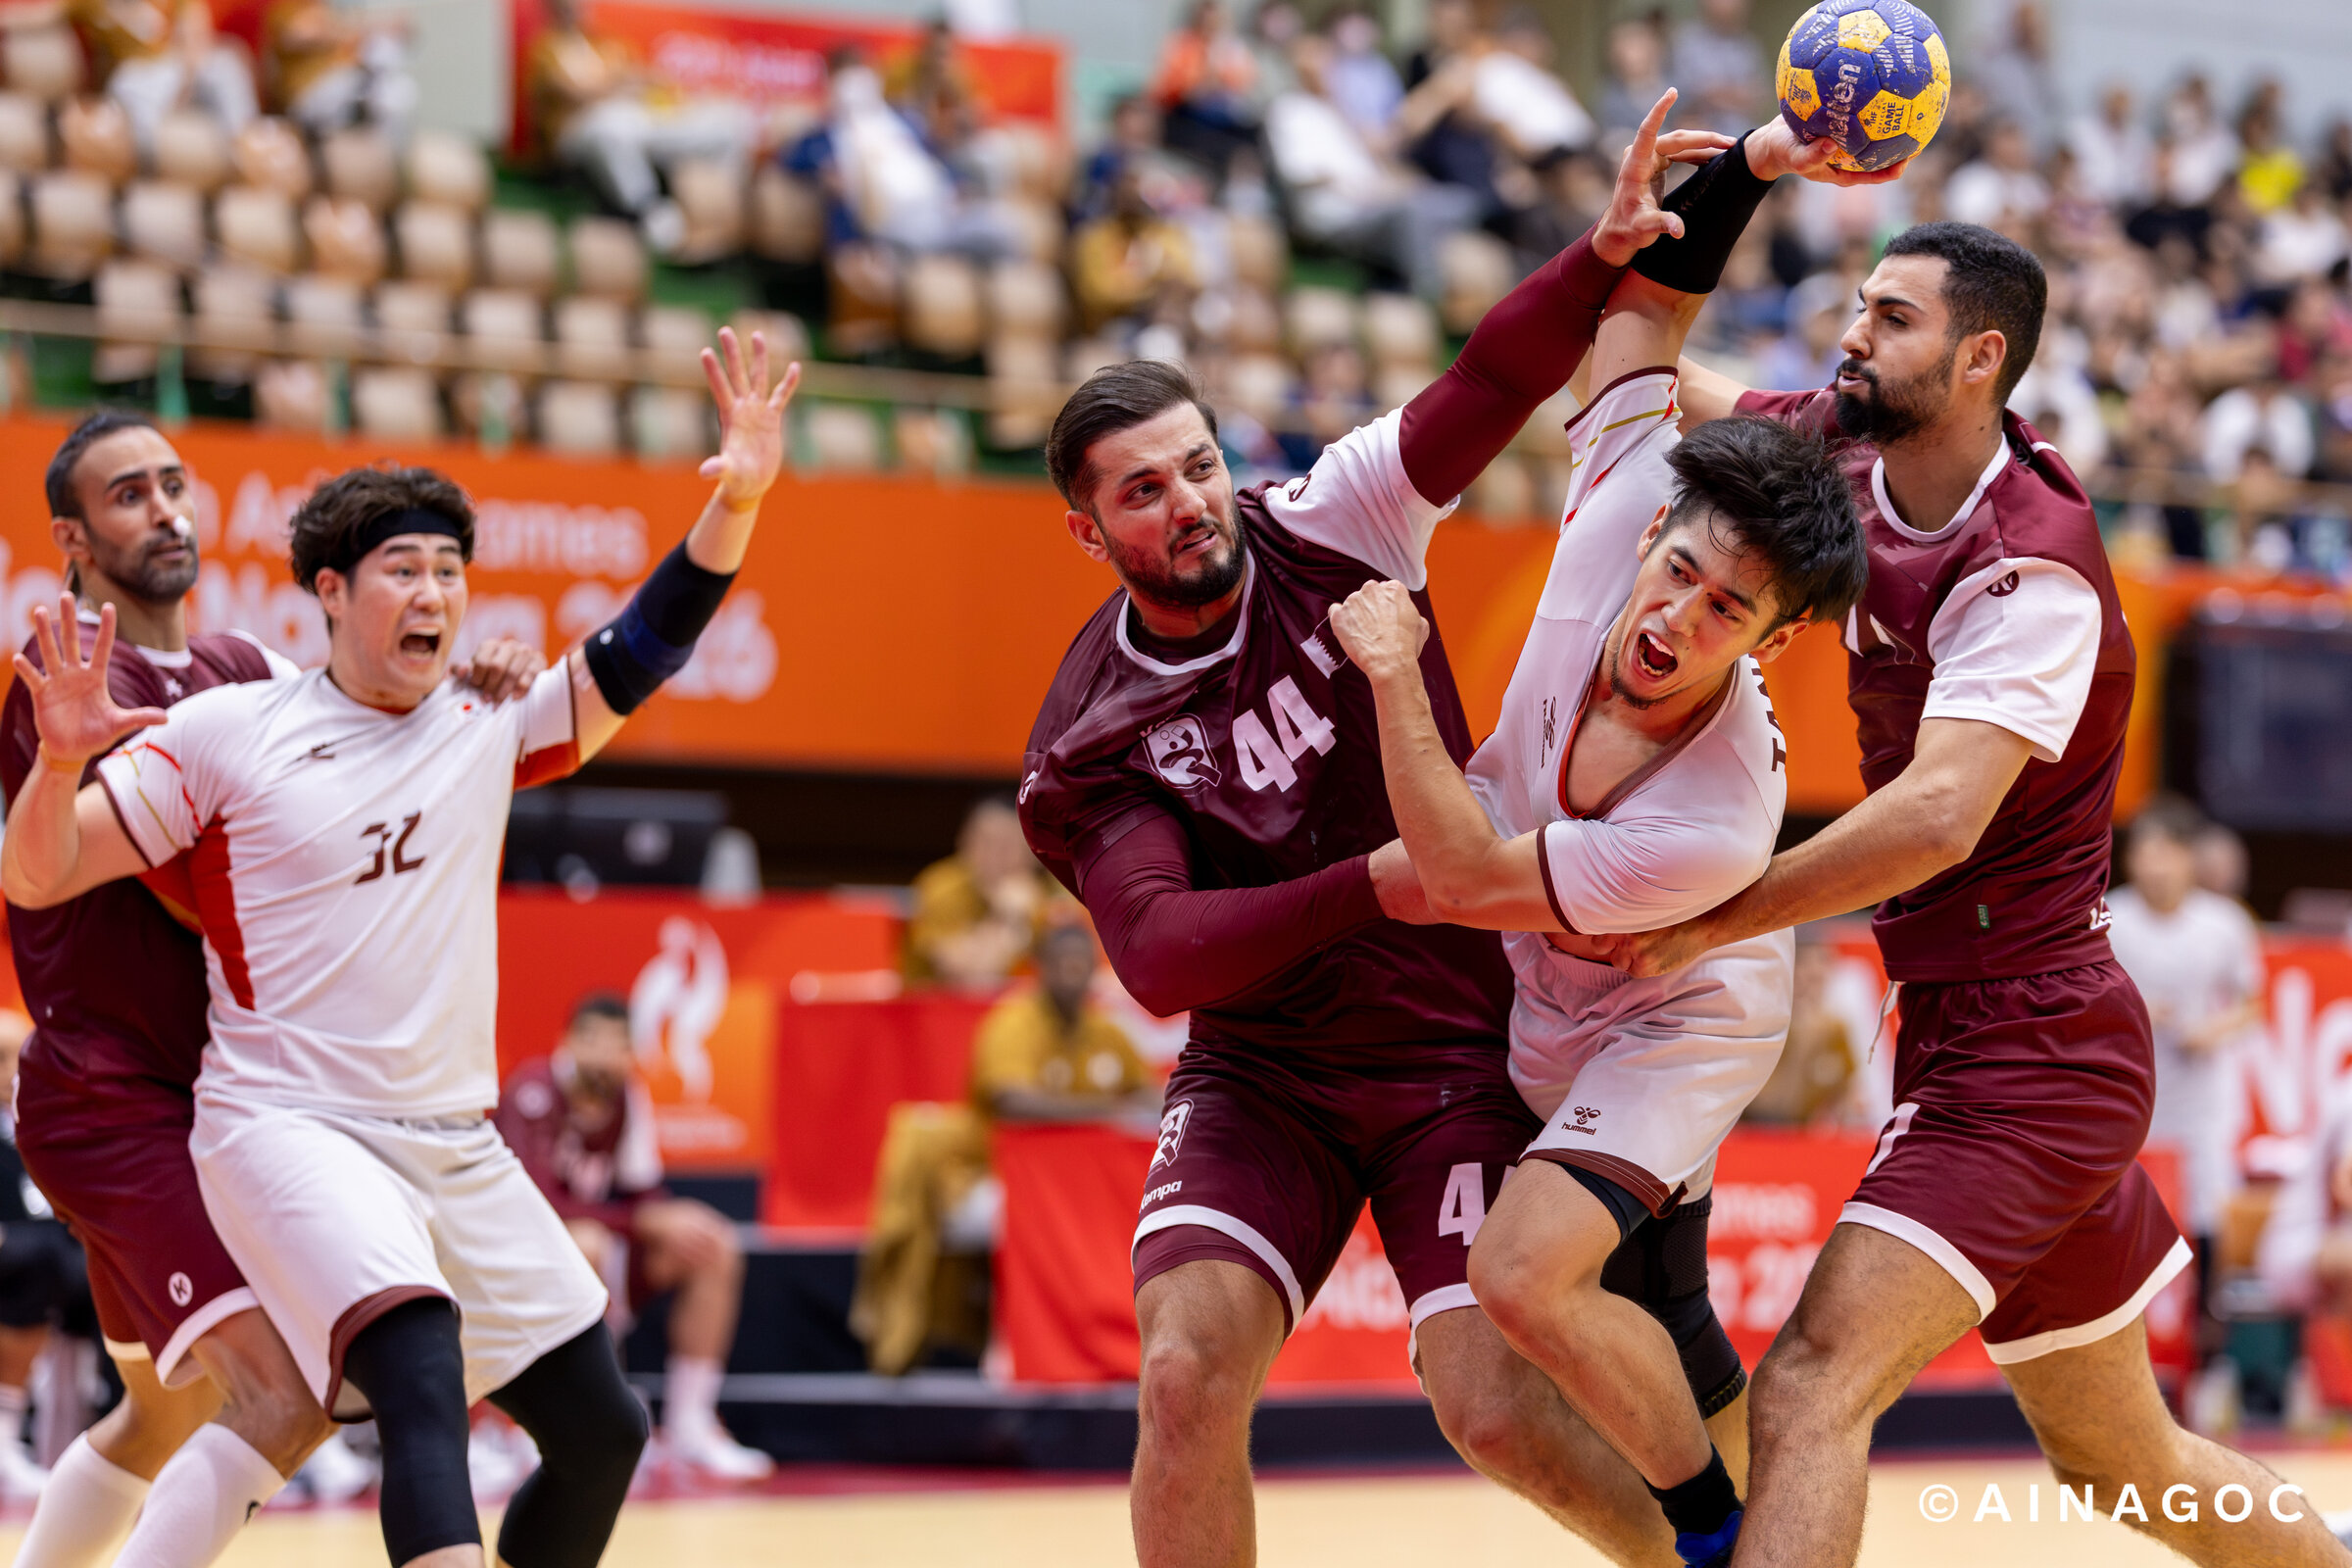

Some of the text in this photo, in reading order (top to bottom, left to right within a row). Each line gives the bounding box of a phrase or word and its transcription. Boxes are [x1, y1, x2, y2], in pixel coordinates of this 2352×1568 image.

[1882, 102, 1896, 134] GAME
[1892, 104, 1904, 131] BALL
[470, 498, 649, 580] ames
[1232, 674, 1338, 793] 44
[353, 809, 425, 885] 32
[1561, 1121, 1596, 1136] hummel
[1438, 1162, 1517, 1247] 4
